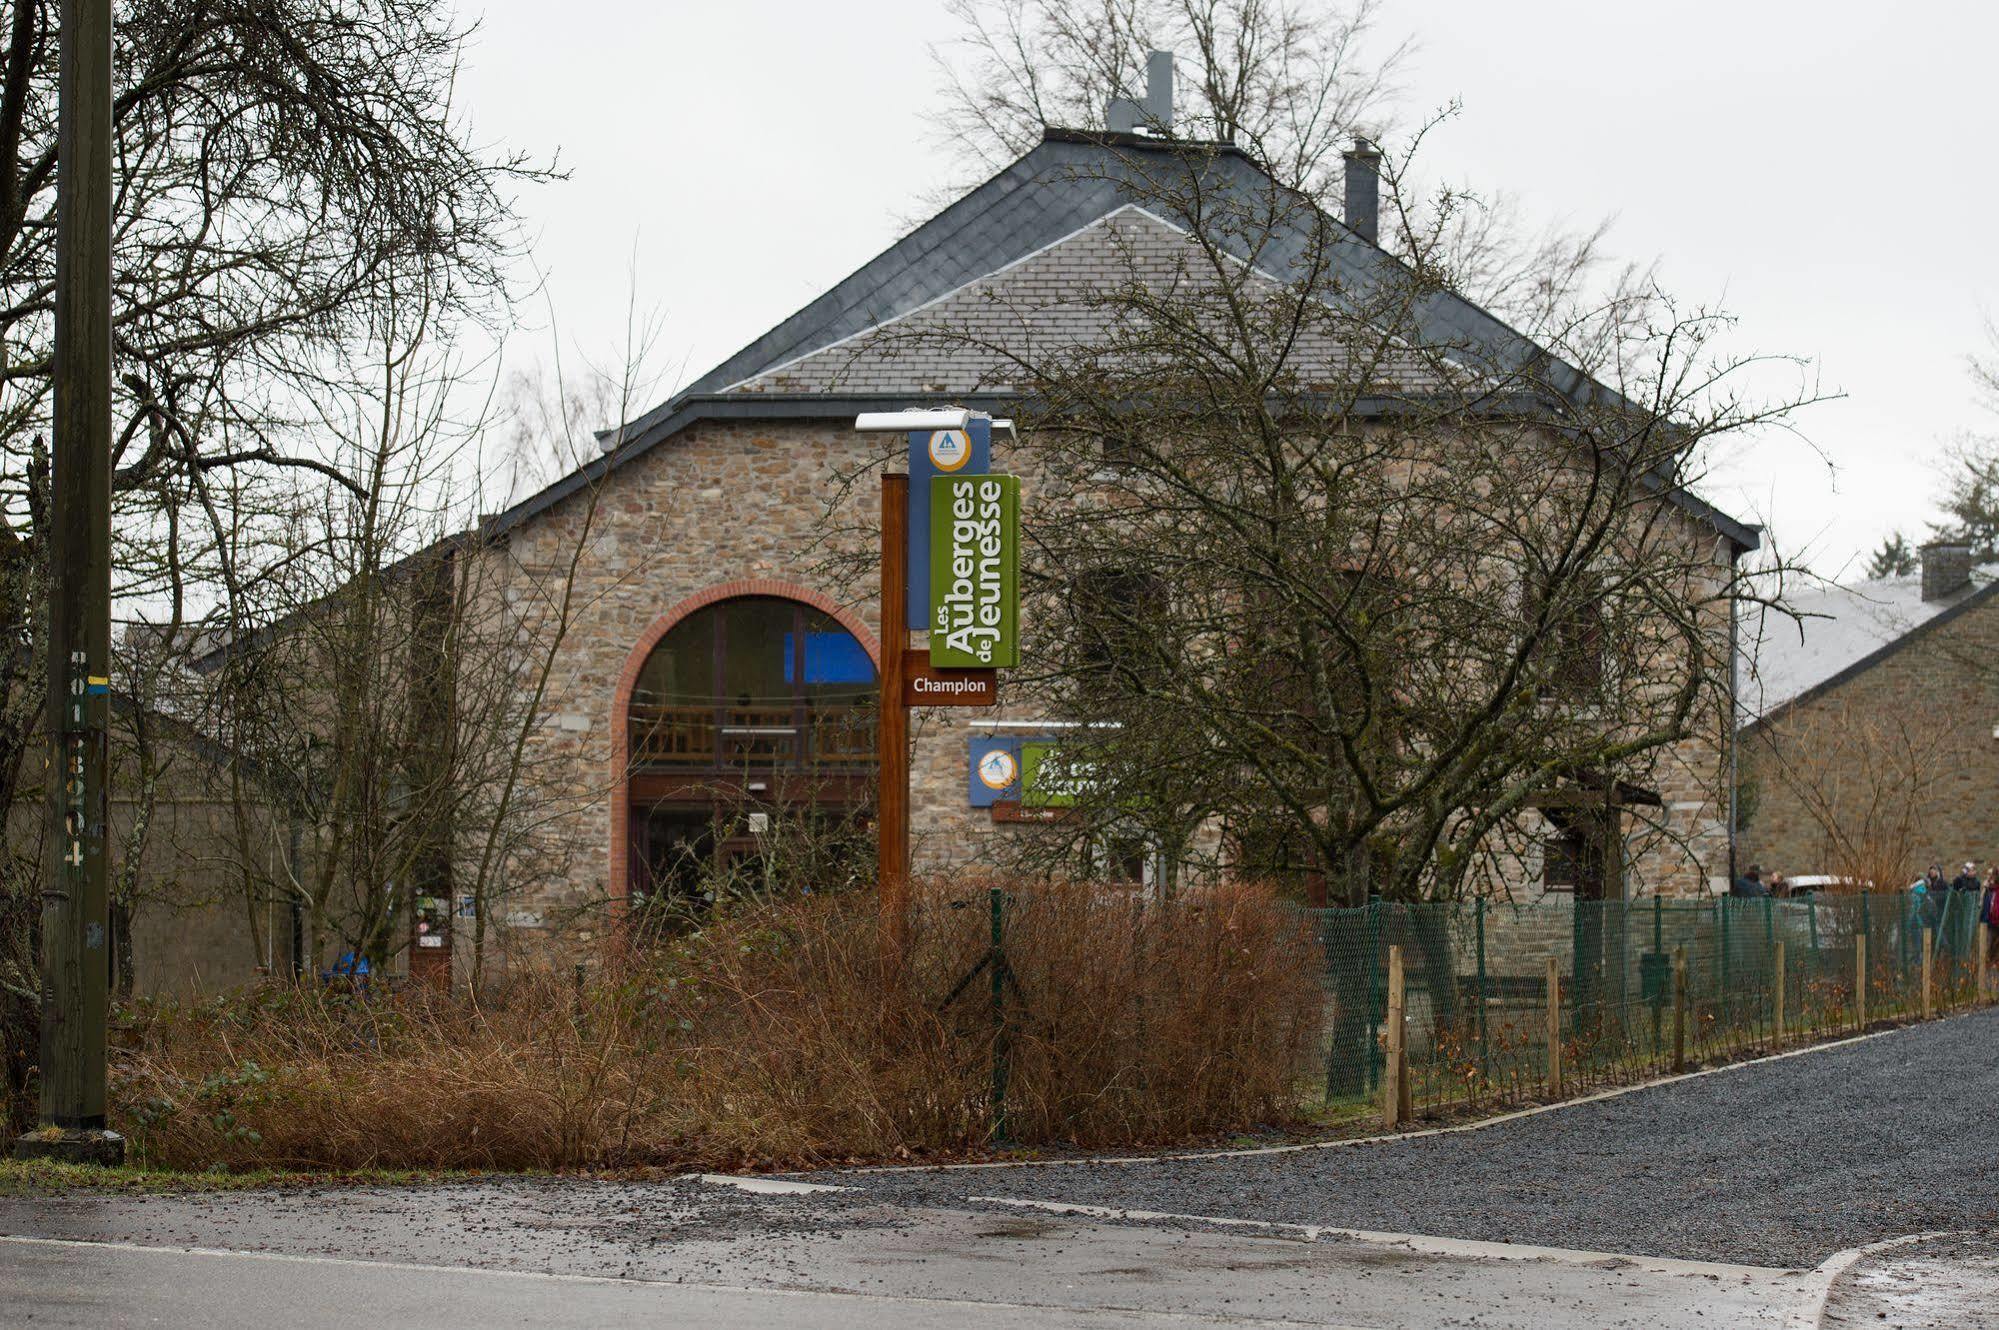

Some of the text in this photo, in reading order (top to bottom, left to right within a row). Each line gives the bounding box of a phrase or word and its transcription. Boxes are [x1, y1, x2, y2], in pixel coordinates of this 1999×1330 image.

[945, 481, 983, 654] Auberges
[972, 480, 1002, 664] de Jeunesse
[935, 606, 949, 635] Les
[913, 676, 987, 696] Champlon
